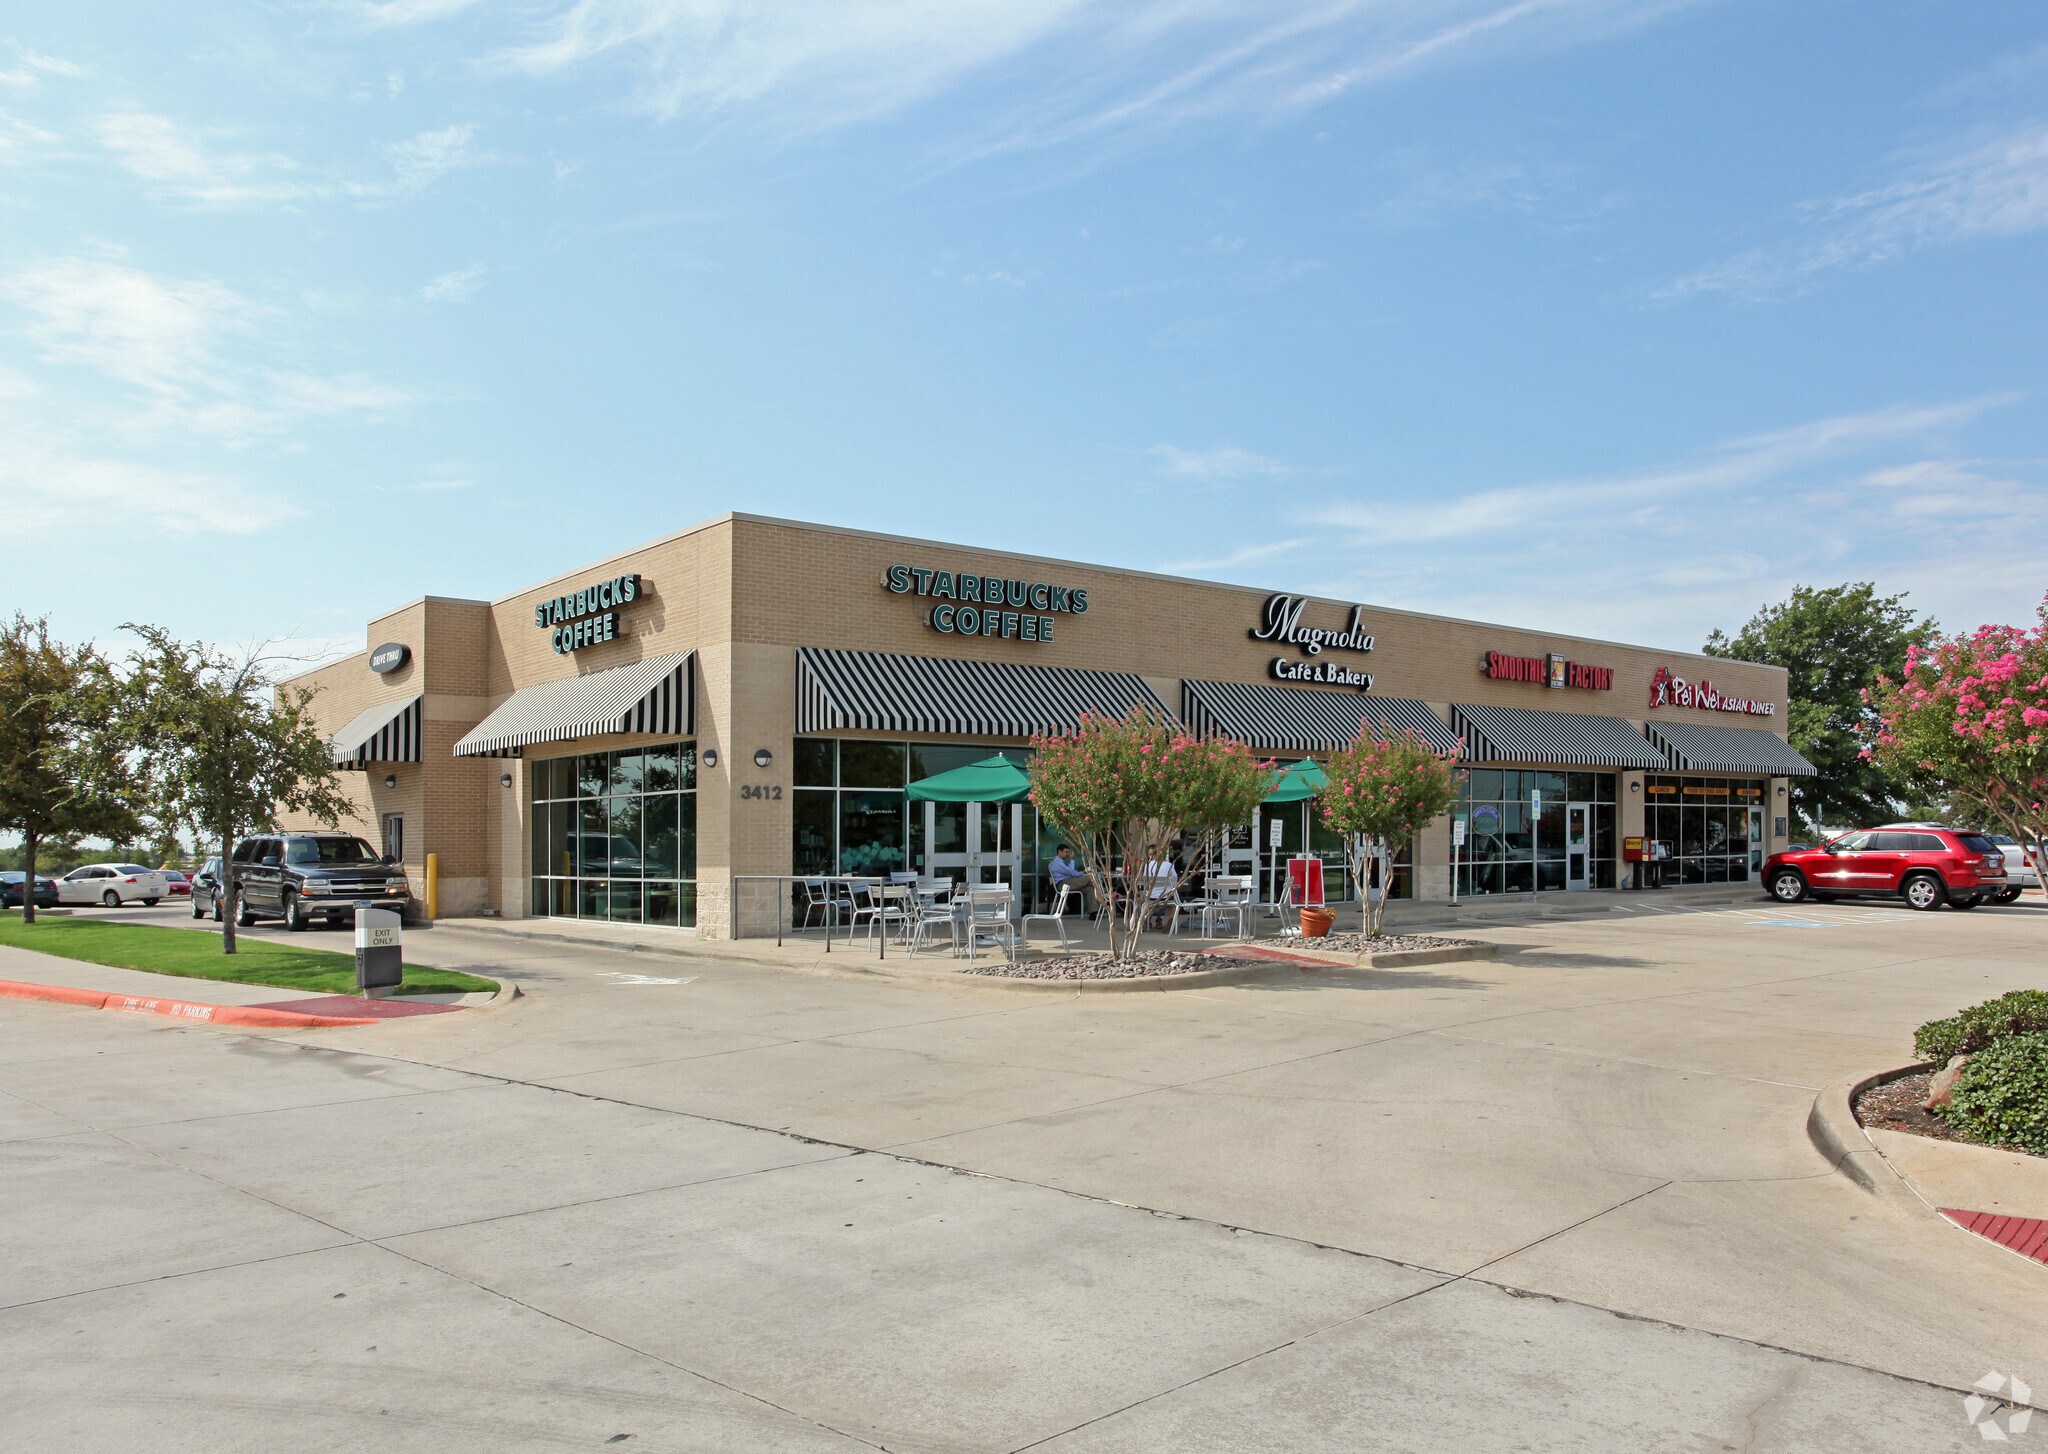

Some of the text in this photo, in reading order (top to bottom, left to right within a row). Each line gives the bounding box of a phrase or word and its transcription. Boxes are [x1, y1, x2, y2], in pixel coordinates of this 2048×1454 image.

[534, 572, 637, 629] STARBUCKS
[889, 564, 1090, 615] STARBUCKS
[551, 612, 614, 655] COFFEE
[932, 603, 1056, 643] COFFEE
[1254, 593, 1376, 655] Magnolia
[373, 649, 400, 667] DRIVE THRU
[1275, 658, 1375, 691] Café & Bakery
[1489, 650, 1615, 691] SMOOTHIE FACTORY
[1672, 676, 1775, 716] Pei Wei ASIAN DINER
[740, 784, 783, 800] 3412
[372, 937, 393, 946] ONLY
[375, 929, 391, 937] EXIT
[170, 1003, 182, 1015] NO
[182, 1005, 213, 1020] PARKING
